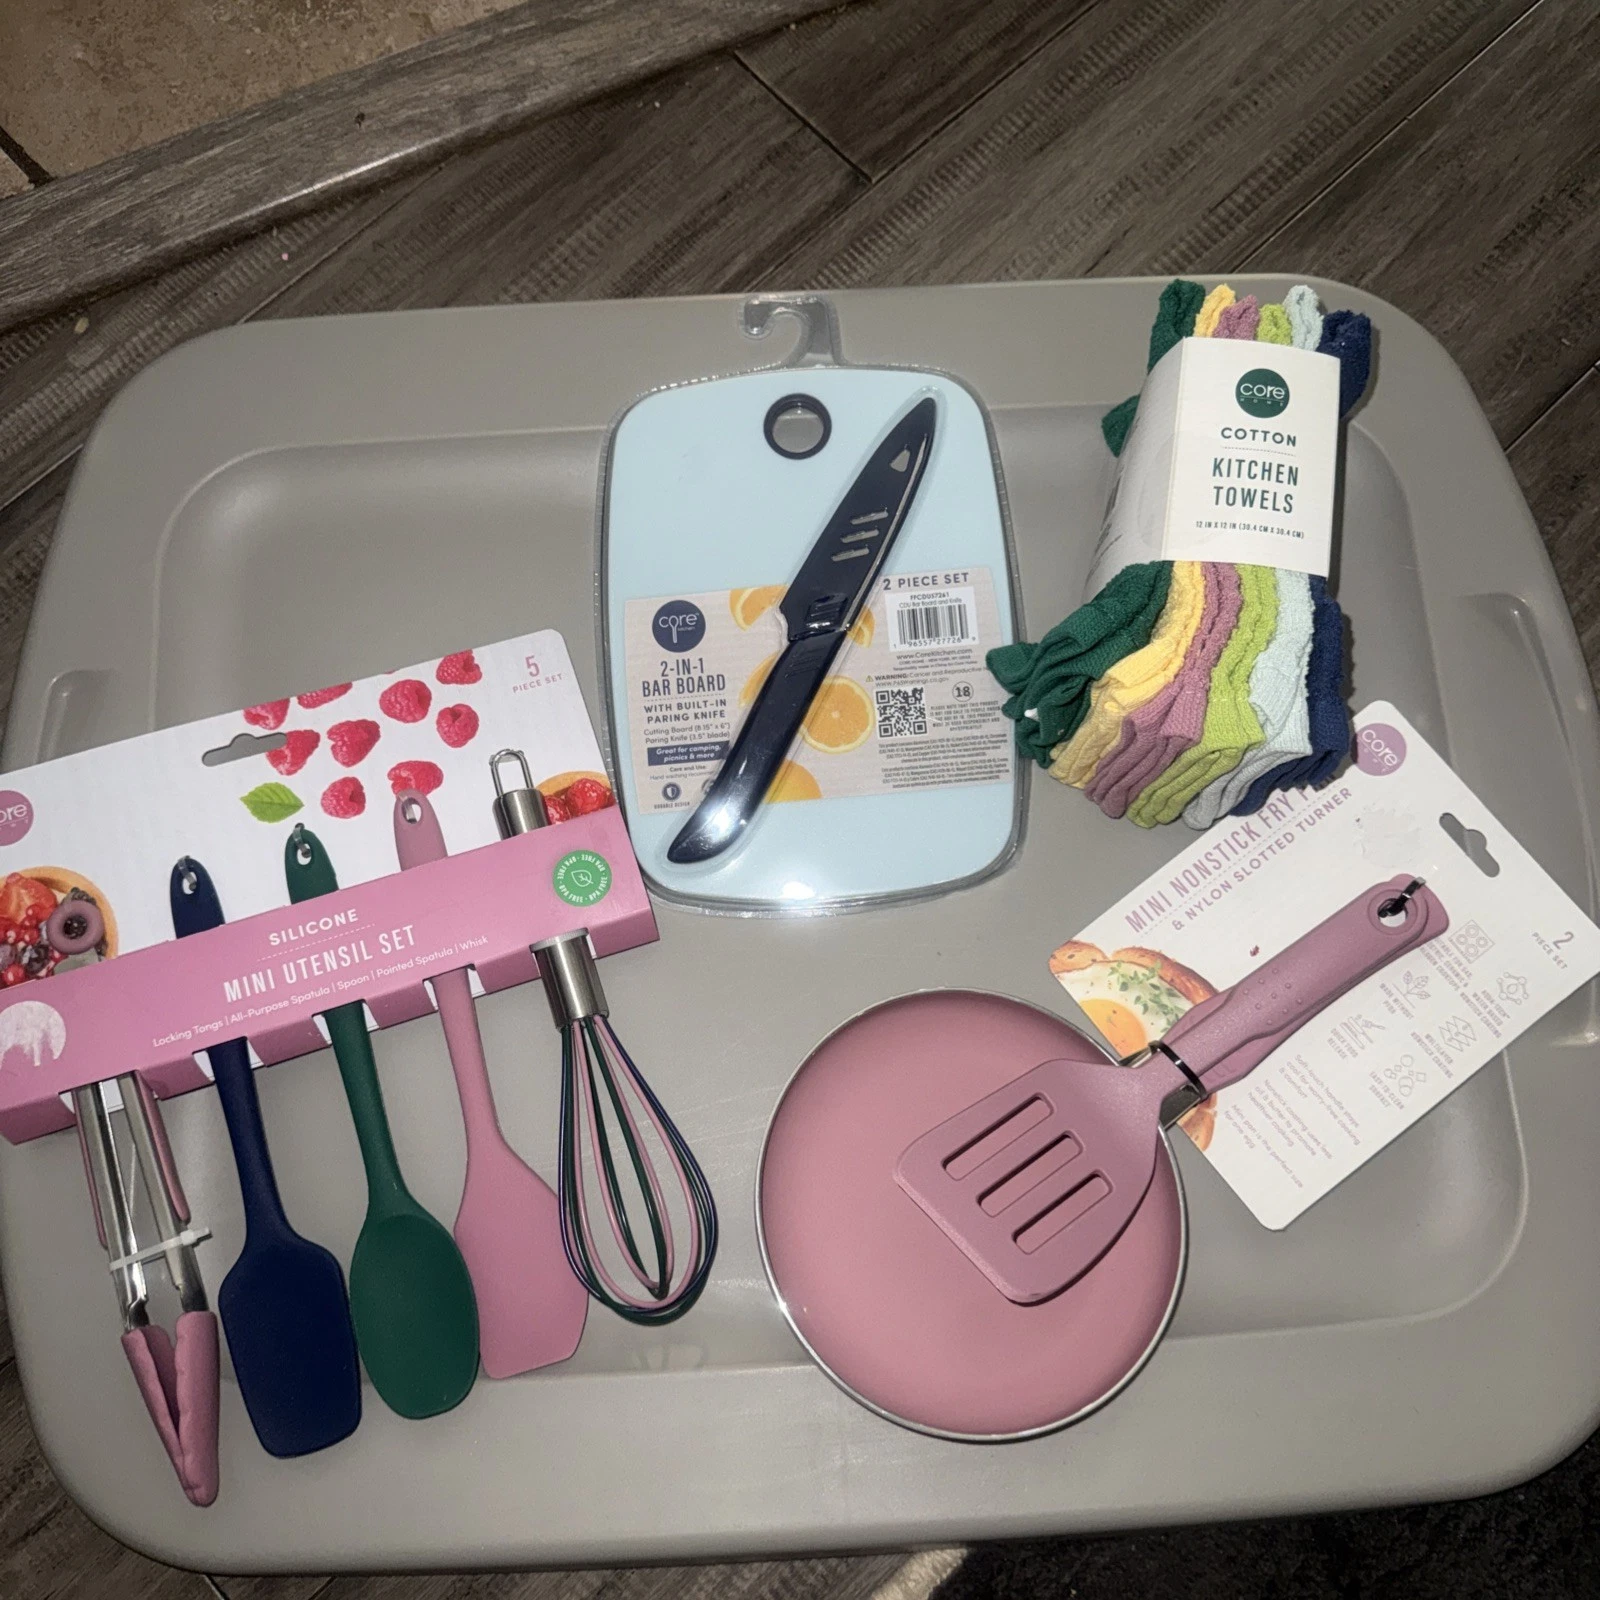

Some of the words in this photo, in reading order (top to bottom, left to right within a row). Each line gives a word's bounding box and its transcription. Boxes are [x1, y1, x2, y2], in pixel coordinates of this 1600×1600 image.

[1240, 383, 1285, 400] core
[1221, 427, 1297, 447] COTTON
[1212, 457, 1299, 486] KITCHEN
[1213, 486, 1293, 514] TOWELS
[1196, 520, 1203, 528] 12
[1204, 521, 1212, 529] IN
[1229, 522, 1237, 530] IN
[1259, 525, 1269, 533] CM
[1292, 530, 1305, 539] CM)
[882, 578, 892, 591] 2
[898, 575, 939, 588] PIECE
[944, 572, 969, 585] SET
[658, 613, 698, 637] core
[896, 648, 973, 660] www.CoreKitchen.com
[525, 655, 540, 678] 5
[660, 657, 704, 678] 2-IN-1
[874, 673, 909, 682] WARNING:
[908, 671, 931, 679] Cancer
[943, 666, 982, 676] Reproductive
[512, 679, 542, 694] PIECE
[544, 673, 563, 684] SET
[642, 679, 671, 698] BAR
[676, 673, 726, 695] BOARD
[955, 686, 971, 698] 18
[644, 703, 672, 714] WITH
[676, 698, 727, 711] BUILT-IN
[647, 712, 690, 725] PARING
[693, 709, 726, 720] KNIFE
[643, 726, 670, 736] Cutting
[671, 725, 693, 734] Board
[645, 735, 669, 744] Paring
[670, 734, 688, 742] Knife
[707, 730, 730, 739] blade)
[656, 746, 677, 755] Great
[677, 746, 688, 754] for
[689, 744, 722, 753] camping,
[663, 753, 688, 763] picnics
[1362, 729, 1398, 766] core
[666, 772, 687, 780] washing
[0, 804, 27, 824] ore
[1125, 890, 1172, 933] MINI
[1169, 821, 1261, 897] NONSTICK
[1256, 792, 1295, 830] FRY
[1171, 919, 1186, 931] &
[1184, 879, 1233, 921] NYLON
[1233, 831, 1296, 883] SLOTTED
[1295, 786, 1353, 833] TURNER
[268, 908, 359, 946] SILICONE
[1531, 931, 1555, 956] PIECE
[1552, 954, 1568, 970] SET
[1553, 930, 1575, 950] 2
[223, 968, 276, 1003] MINI
[282, 940, 373, 984] UTENSIL
[378, 925, 416, 954] SET
[152, 1028, 192, 1047] Locking
[192, 1019, 224, 1035] Tongs
[230, 999, 290, 1023] All-Purpose
[290, 986, 331, 1005] Spatula
[336, 974, 370, 992] Spoon
[376, 958, 414, 978] Pointed
[415, 946, 454, 965] Spatula
[459, 935, 489, 951] Whisk
[1284, 1073, 1307, 1098] comfort
[1295, 1054, 1324, 1087] Soft-touch
[1324, 1087, 1344, 1110] handle
[1343, 1111, 1358, 1127] stays
[1286, 1061, 1300, 1075] cool
[1299, 1075, 1308, 1085] for
[1307, 1084, 1338, 1119] worry-free
[1337, 1119, 1360, 1145] cooking
[1223, 1111, 1233, 1121] for
[1232, 1122, 1243, 1133] one
[1242, 1134, 1255, 1148] egg
[1247, 1092, 1272, 1120] healthier
[1271, 1121, 1294, 1146] cooking
[1263, 1079, 1286, 1105] Nonstick
[1286, 1106, 1307, 1130] coating
[1307, 1131, 1320, 1145] uses
[1320, 1145, 1332, 1158] less
[1267, 1100, 1285, 1120] butter
[1291, 1128, 1316, 1156] promote
[1231, 1104, 1245, 1119] Mini
[1244, 1120, 1256, 1133] pan
[1261, 1139, 1271, 1150] the
[1270, 1150, 1292, 1174] perfect
